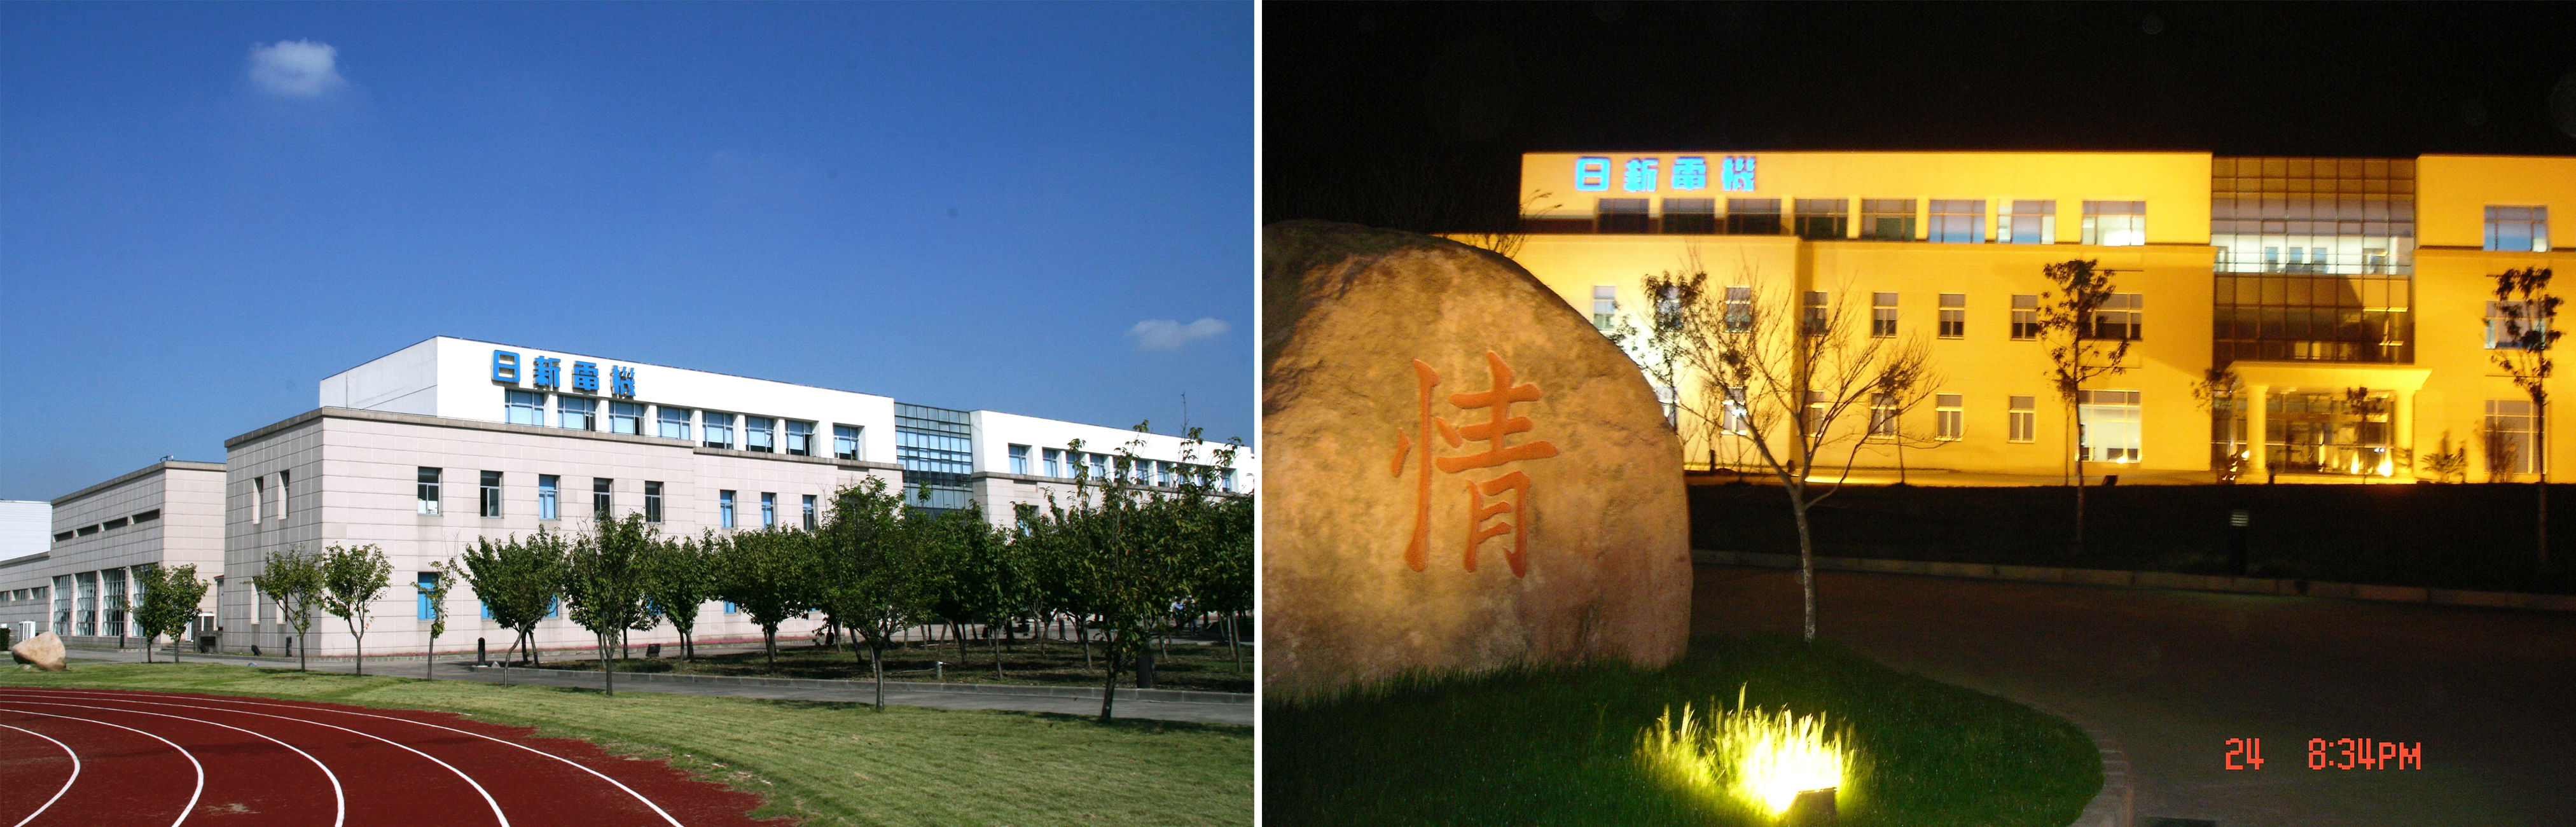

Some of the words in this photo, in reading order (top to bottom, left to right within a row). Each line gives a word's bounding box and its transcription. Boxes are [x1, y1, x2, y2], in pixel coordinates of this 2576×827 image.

[491, 350, 637, 397] 日新電機
[1390, 351, 1559, 578] 情
